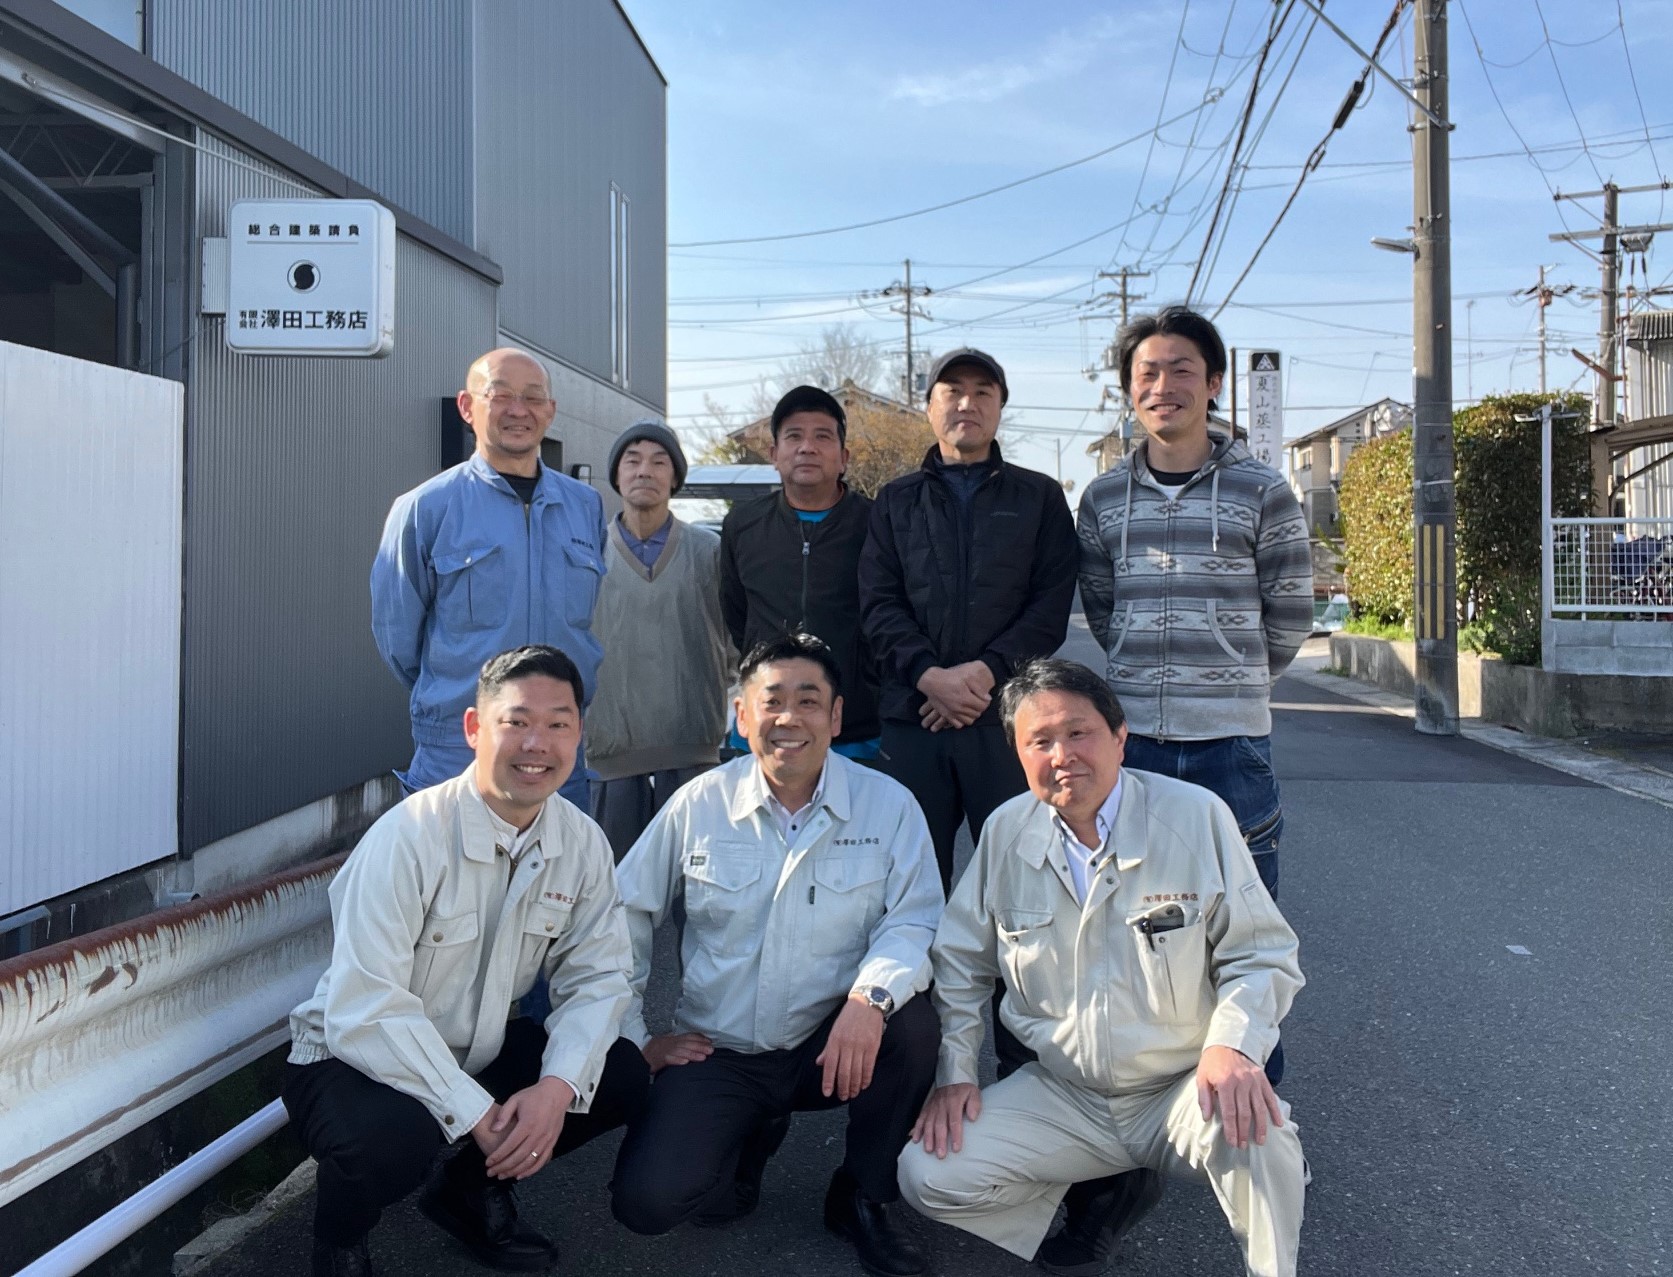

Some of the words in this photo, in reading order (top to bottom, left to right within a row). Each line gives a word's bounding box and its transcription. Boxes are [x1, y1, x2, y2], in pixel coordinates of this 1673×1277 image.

[248, 224, 360, 236] 総合建築請負
[261, 309, 368, 330] 澤田工務店
